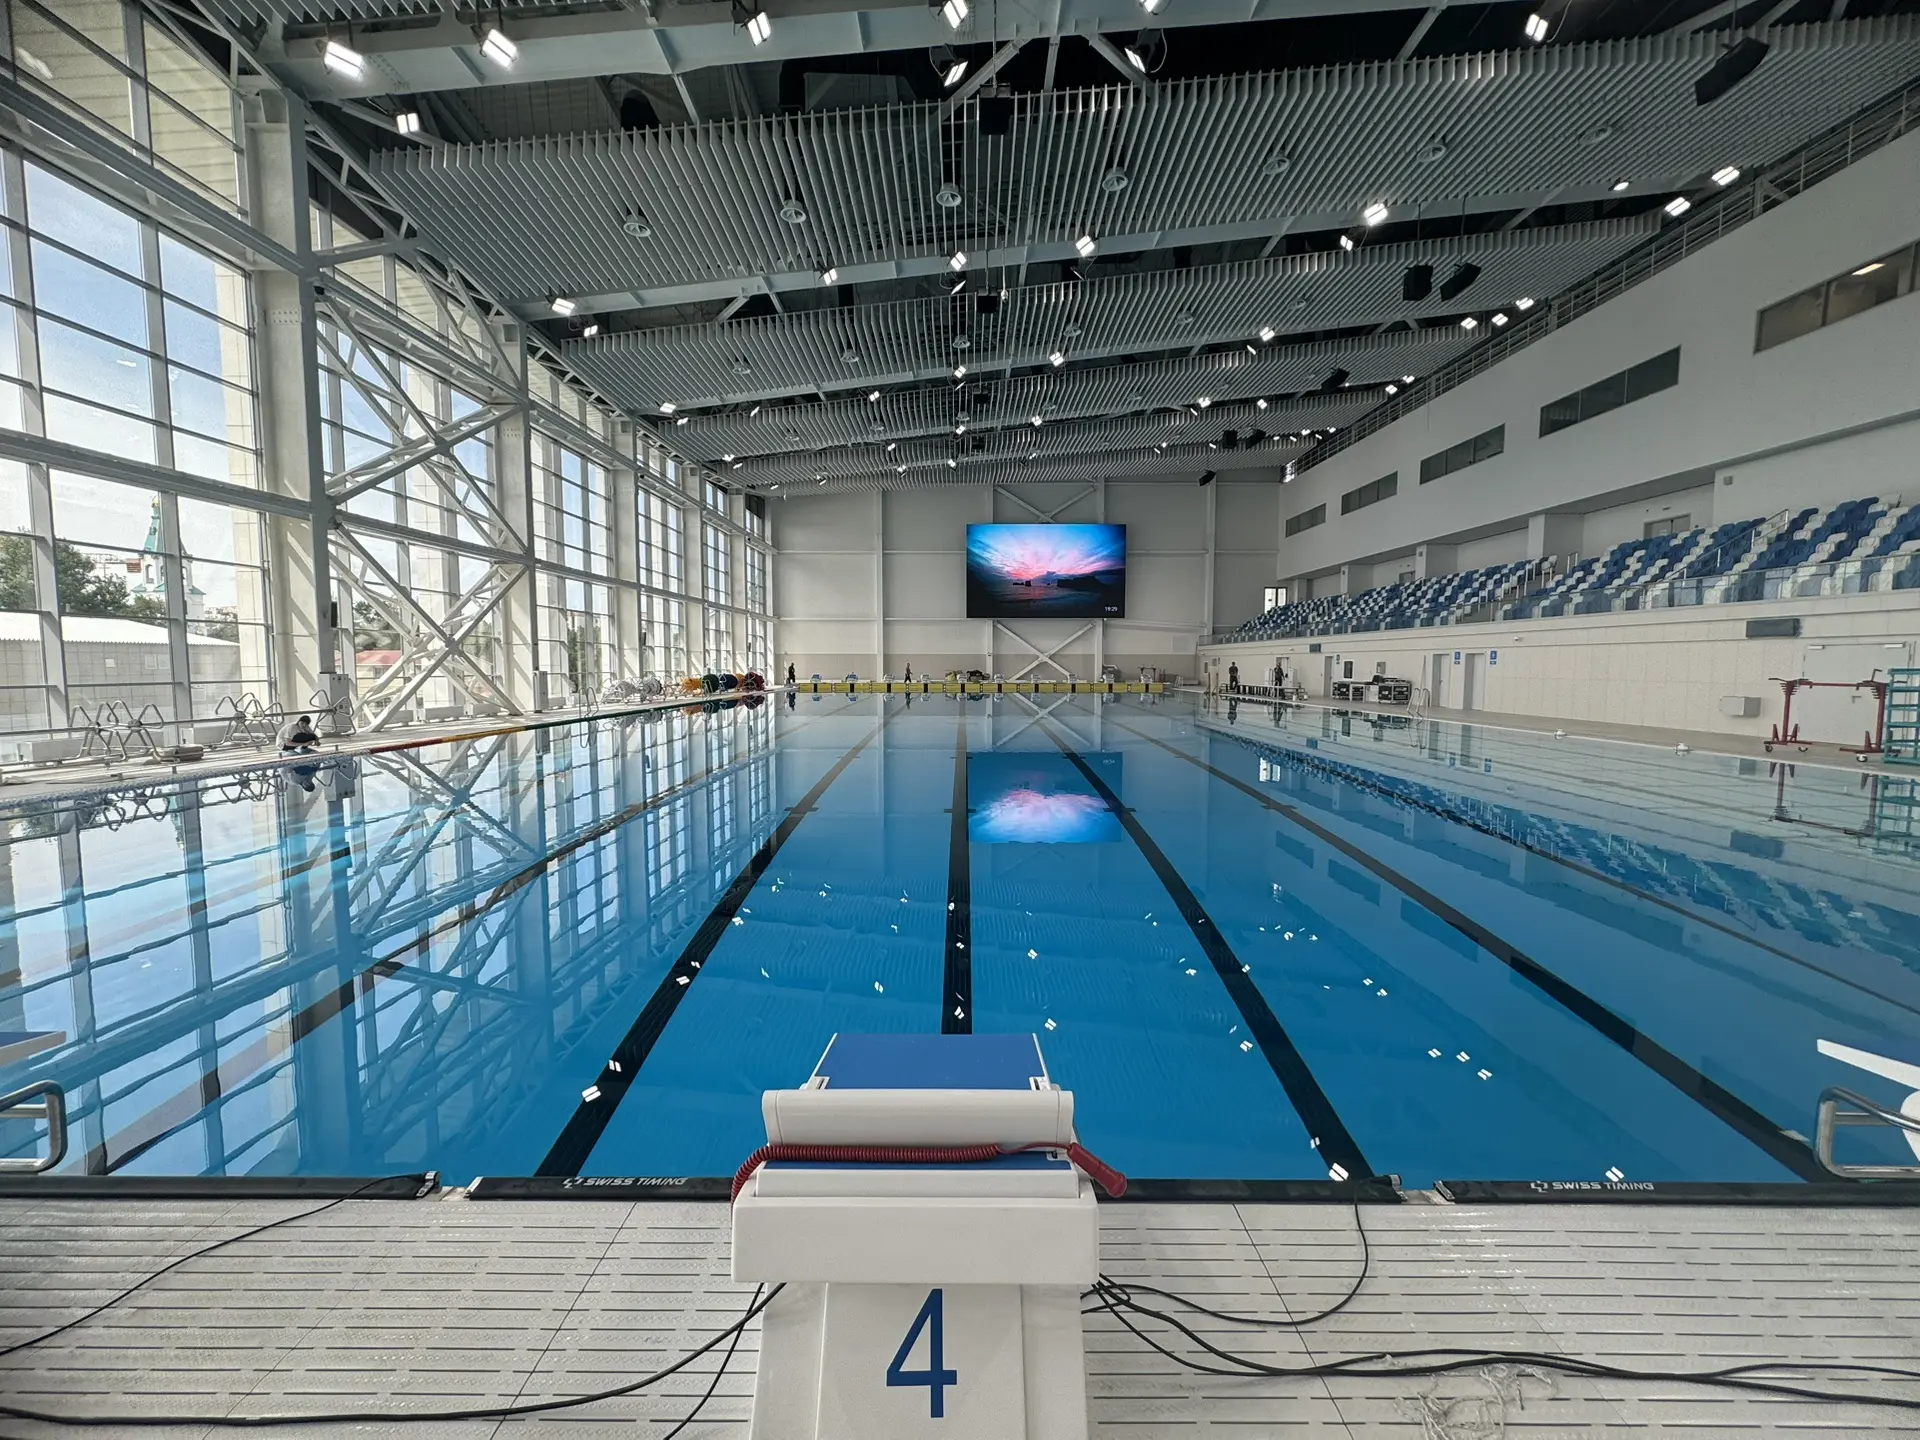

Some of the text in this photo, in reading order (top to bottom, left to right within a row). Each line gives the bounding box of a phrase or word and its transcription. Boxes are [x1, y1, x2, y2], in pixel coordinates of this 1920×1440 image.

[584, 1178, 688, 1186] SWISS TIMING
[1604, 1182, 1654, 1190] TIMING
[886, 1288, 957, 1418] 4
